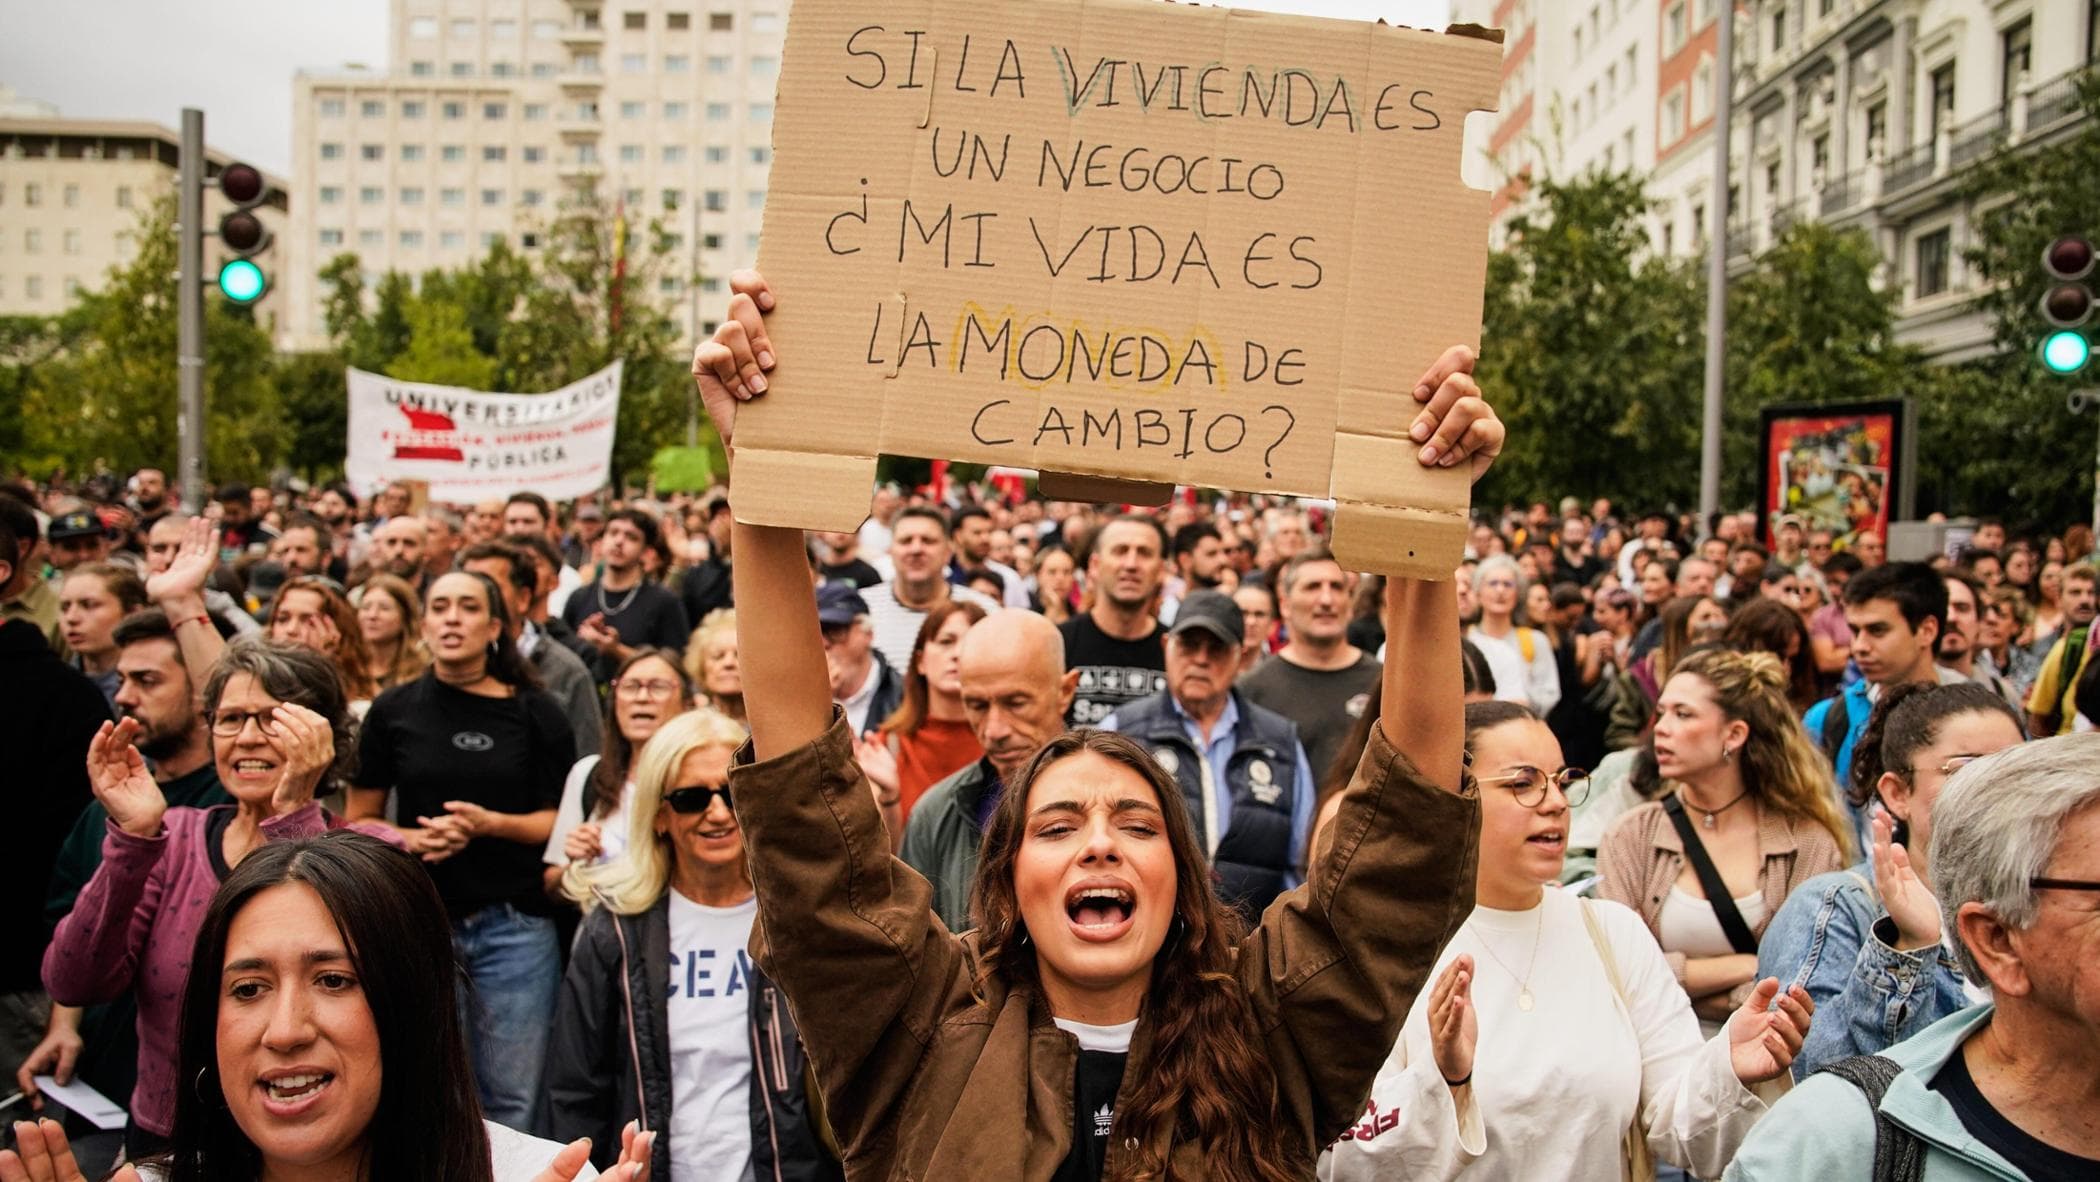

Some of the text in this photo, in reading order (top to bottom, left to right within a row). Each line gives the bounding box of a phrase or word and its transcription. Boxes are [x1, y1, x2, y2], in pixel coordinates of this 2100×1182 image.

[845, 26, 1442, 133] SI LA VIVIENDA ES
[931, 127, 1285, 200] UN NEGOCIO
[1029, 217, 1220, 289] VIDA
[1243, 232, 1323, 289] ES
[866, 303, 1307, 386] LA MONEDA DE
[971, 400, 1296, 480] CAMBIO?
[1333, 1107, 1400, 1143] FIRS
